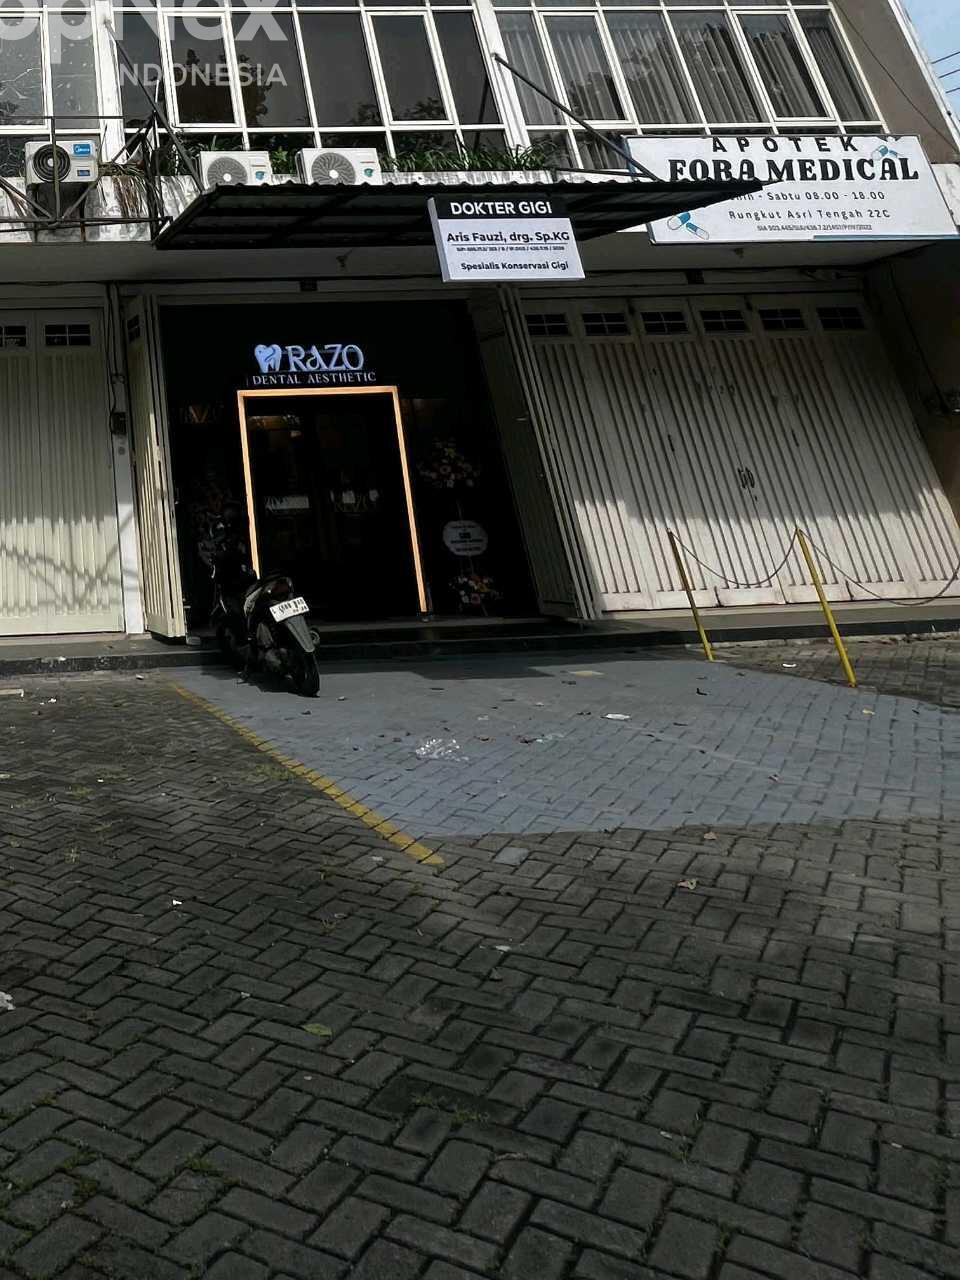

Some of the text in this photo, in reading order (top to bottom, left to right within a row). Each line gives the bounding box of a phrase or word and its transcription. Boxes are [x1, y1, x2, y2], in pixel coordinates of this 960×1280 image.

[712, 136, 858, 153] APOTEK
[765, 157, 919, 182] MEDICAL
[767, 191, 801, 201] Sabtu
[805, 191, 839, 200] 08.00
[852, 191, 885, 200] 18.00
[450, 200, 553, 215] DOKTER GIGI
[728, 209, 891, 221] Rungkut Asri Tengah 22C
[447, 231, 570, 243] Aris Fauzi, drg. Sp.KG
[460, 261, 569, 271] Spesialis Konservasi Gigi
[285, 343, 365, 372] RAZO
[252, 371, 377, 385] DENTAL AESTHETIC
